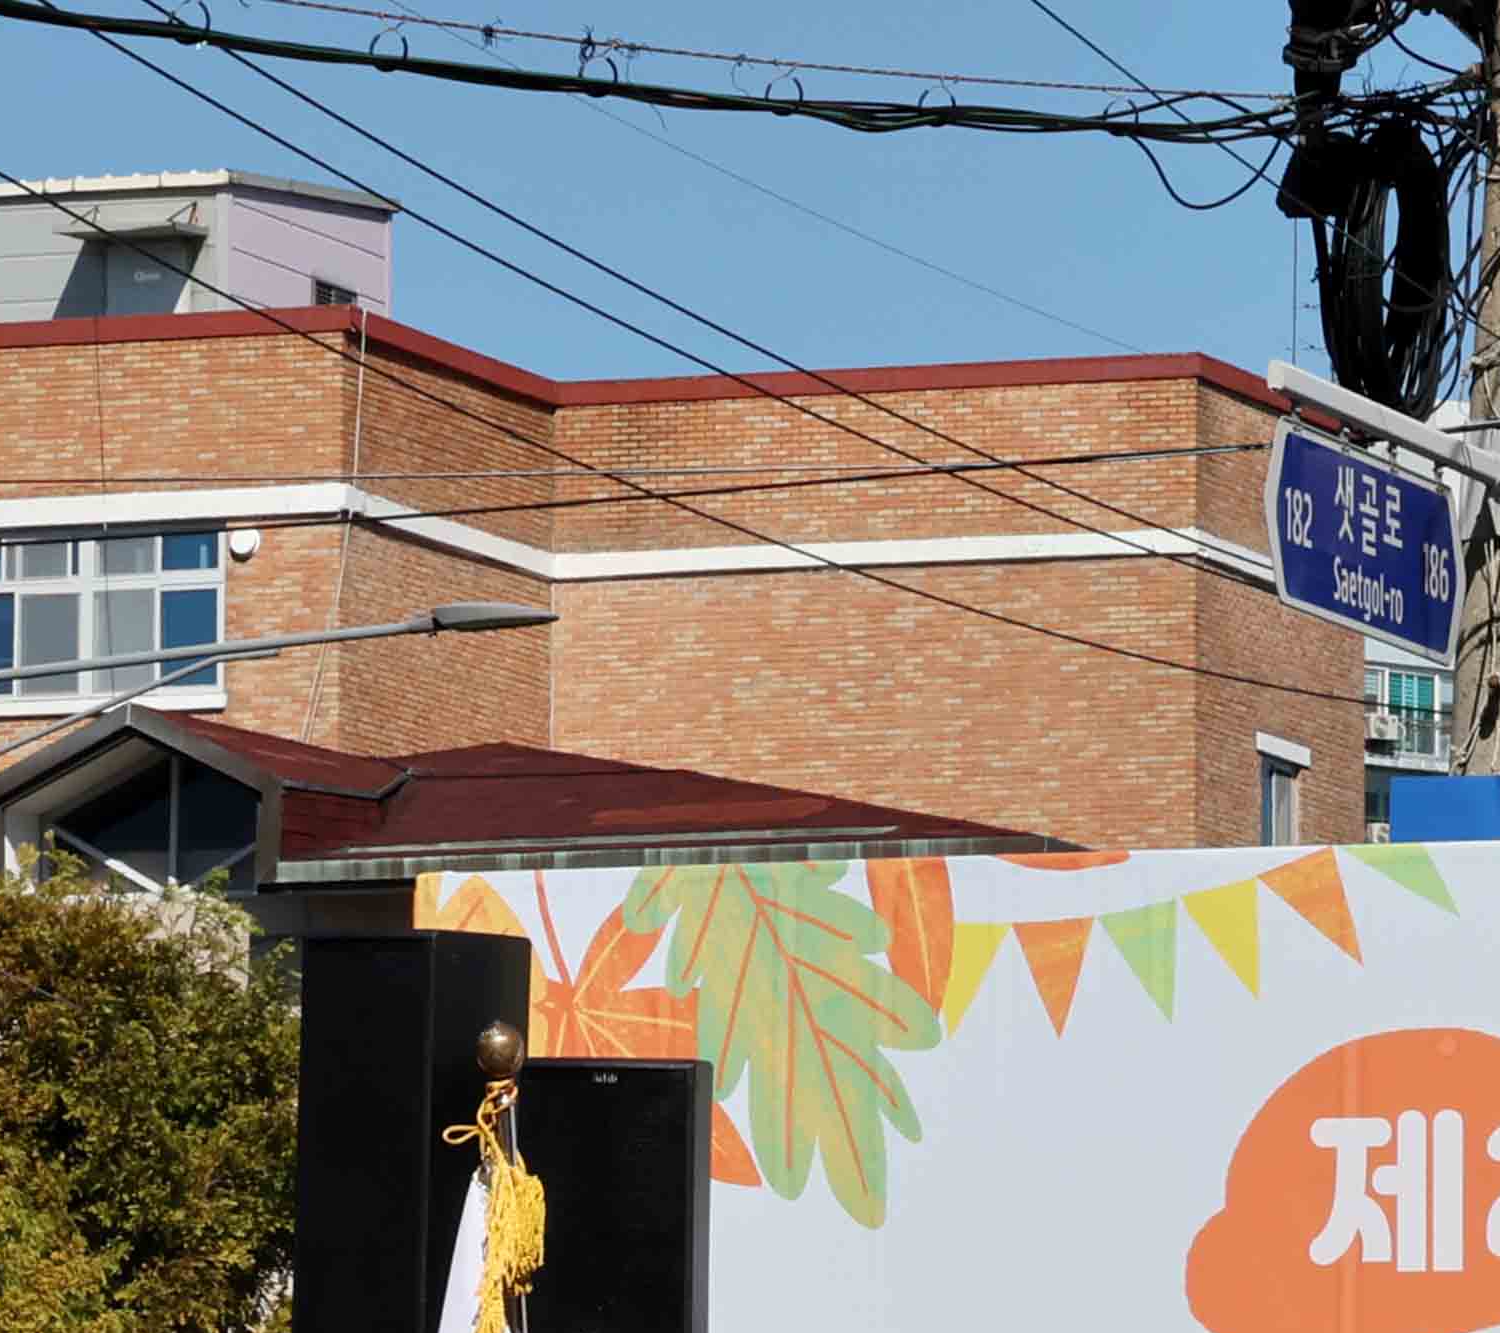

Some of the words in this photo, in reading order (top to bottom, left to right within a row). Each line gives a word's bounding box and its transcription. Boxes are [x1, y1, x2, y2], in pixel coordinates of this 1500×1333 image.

[1284, 487, 1314, 550] 182
[1334, 465, 1404, 557] 샛골로
[1422, 543, 1450, 603] 186
[1333, 556, 1404, 625] Saetgol-ro
